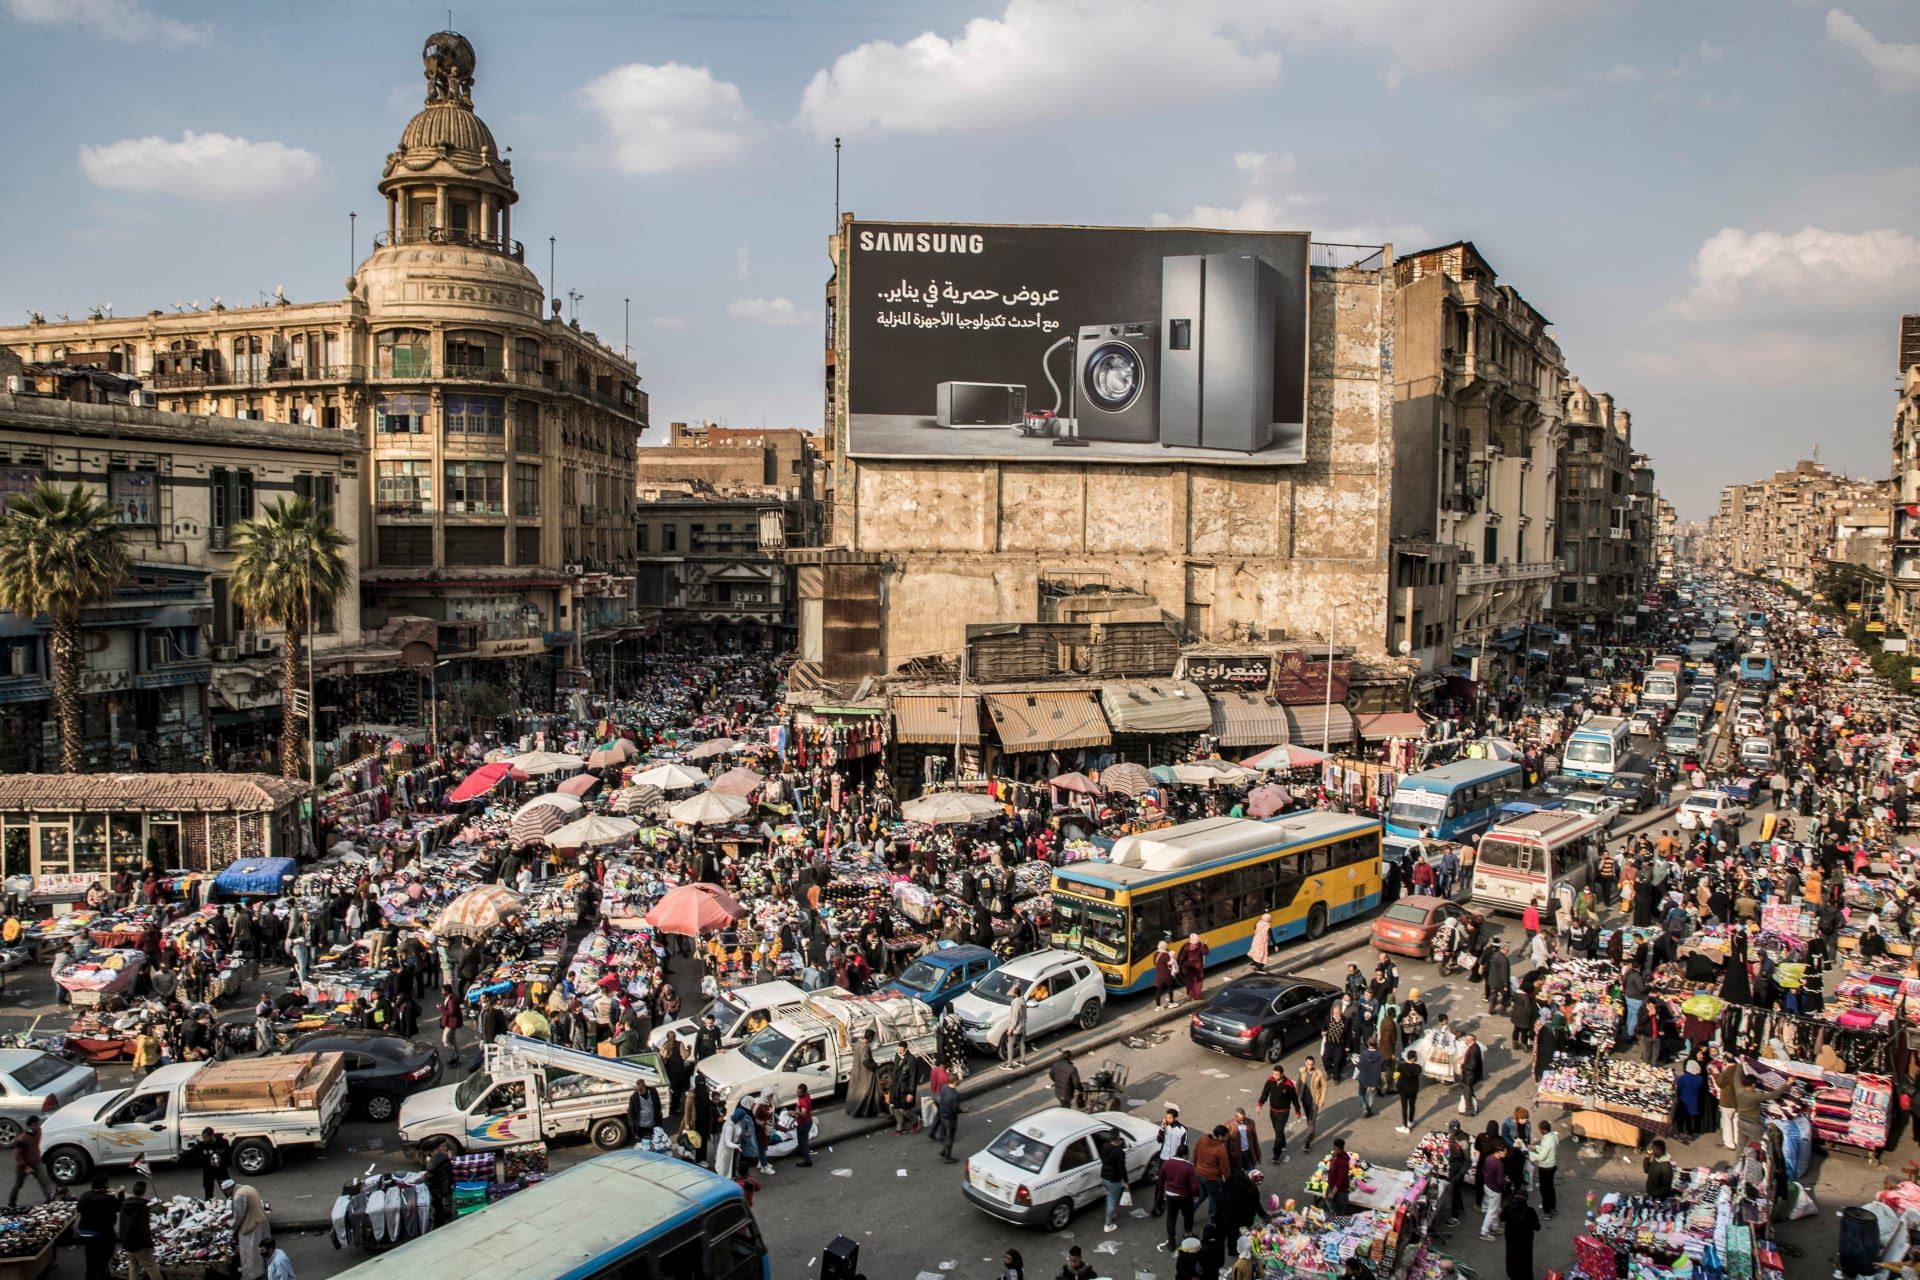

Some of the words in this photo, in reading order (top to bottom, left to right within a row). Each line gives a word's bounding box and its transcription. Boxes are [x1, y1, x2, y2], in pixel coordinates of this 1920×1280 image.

[859, 230, 984, 255] SAMSUNG
[426, 284, 518, 307] TIRING
[877, 280, 920, 303] يناير..
[922, 280, 939, 308] في
[942, 281, 1000, 305] حصرية
[1002, 285, 1060, 306] عروض
[876, 311, 912, 327] المنزلية
[912, 311, 954, 329] الأجهزة
[956, 312, 1006, 330] تكنولوجيا
[1007, 312, 1042, 328] أحدث
[1042, 318, 1060, 333] مع
[1189, 662, 1268, 682] شعراوي
